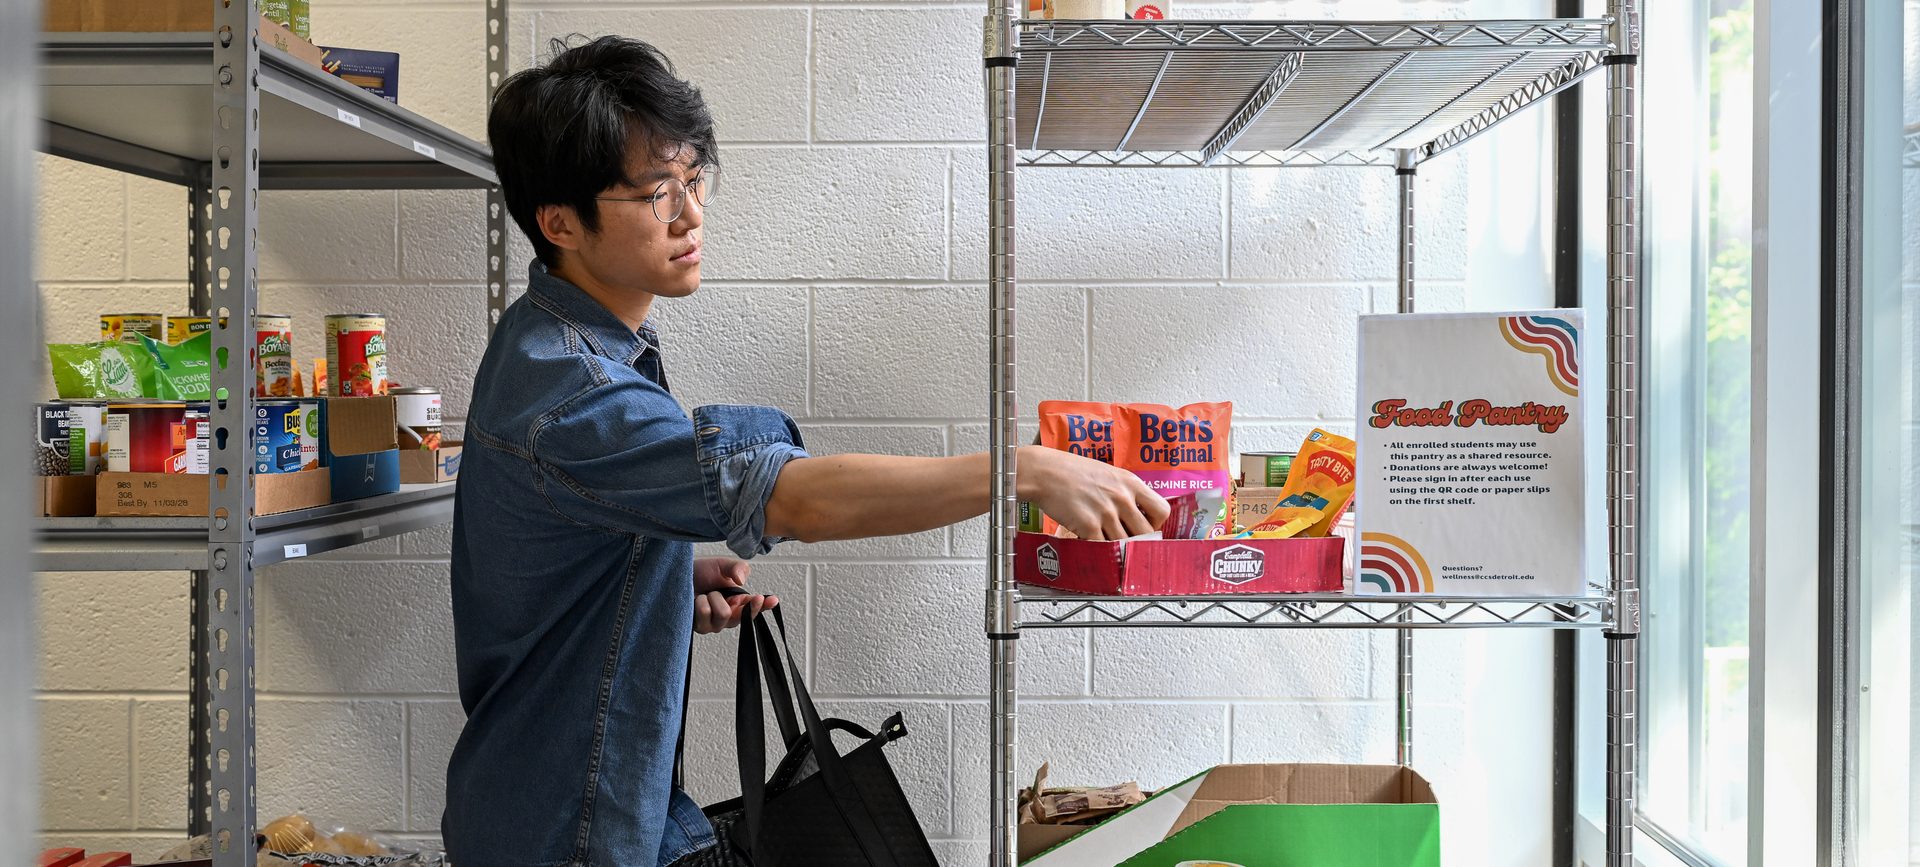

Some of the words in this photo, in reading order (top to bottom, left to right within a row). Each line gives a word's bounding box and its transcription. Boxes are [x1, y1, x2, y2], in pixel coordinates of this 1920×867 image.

[45, 410, 65, 419] BLACK
[1368, 399, 1454, 429] Food
[1453, 399, 1570, 435] Pantry
[1138, 412, 1214, 444] Ben's
[1390, 441, 1404, 449] All
[1406, 441, 1448, 449] enrolled
[1450, 441, 1494, 449] students
[1496, 442, 1518, 450] may
[1139, 443, 1214, 467] Original
[1390, 452, 1409, 460] this
[1411, 453, 1445, 462] pantry
[1467, 452, 1502, 460] shared
[1310, 455, 1336, 471] TASTY
[1331, 461, 1353, 483] BITE
[1461, 463, 1497, 472] always
[1499, 462, 1548, 471] welcome!
[1424, 475, 1446, 484] sign
[1487, 474, 1512, 482] each
[1144, 480, 1187, 489] ASMINE
[1189, 480, 1214, 489] RICE
[1389, 486, 1417, 495] using
[1419, 486, 1436, 494] the
[1438, 486, 1453, 495] QR
[1455, 486, 1479, 494] code
[1494, 487, 1525, 495] paper
[1526, 485, 1551, 495] slips
[117, 499, 135, 507] Best
[136, 499, 148, 508] By
[1404, 497, 1421, 505] the
[1423, 497, 1445, 505] first
[1447, 497, 1476, 505] shelf.
[1214, 559, 1263, 574] CHUNKY
